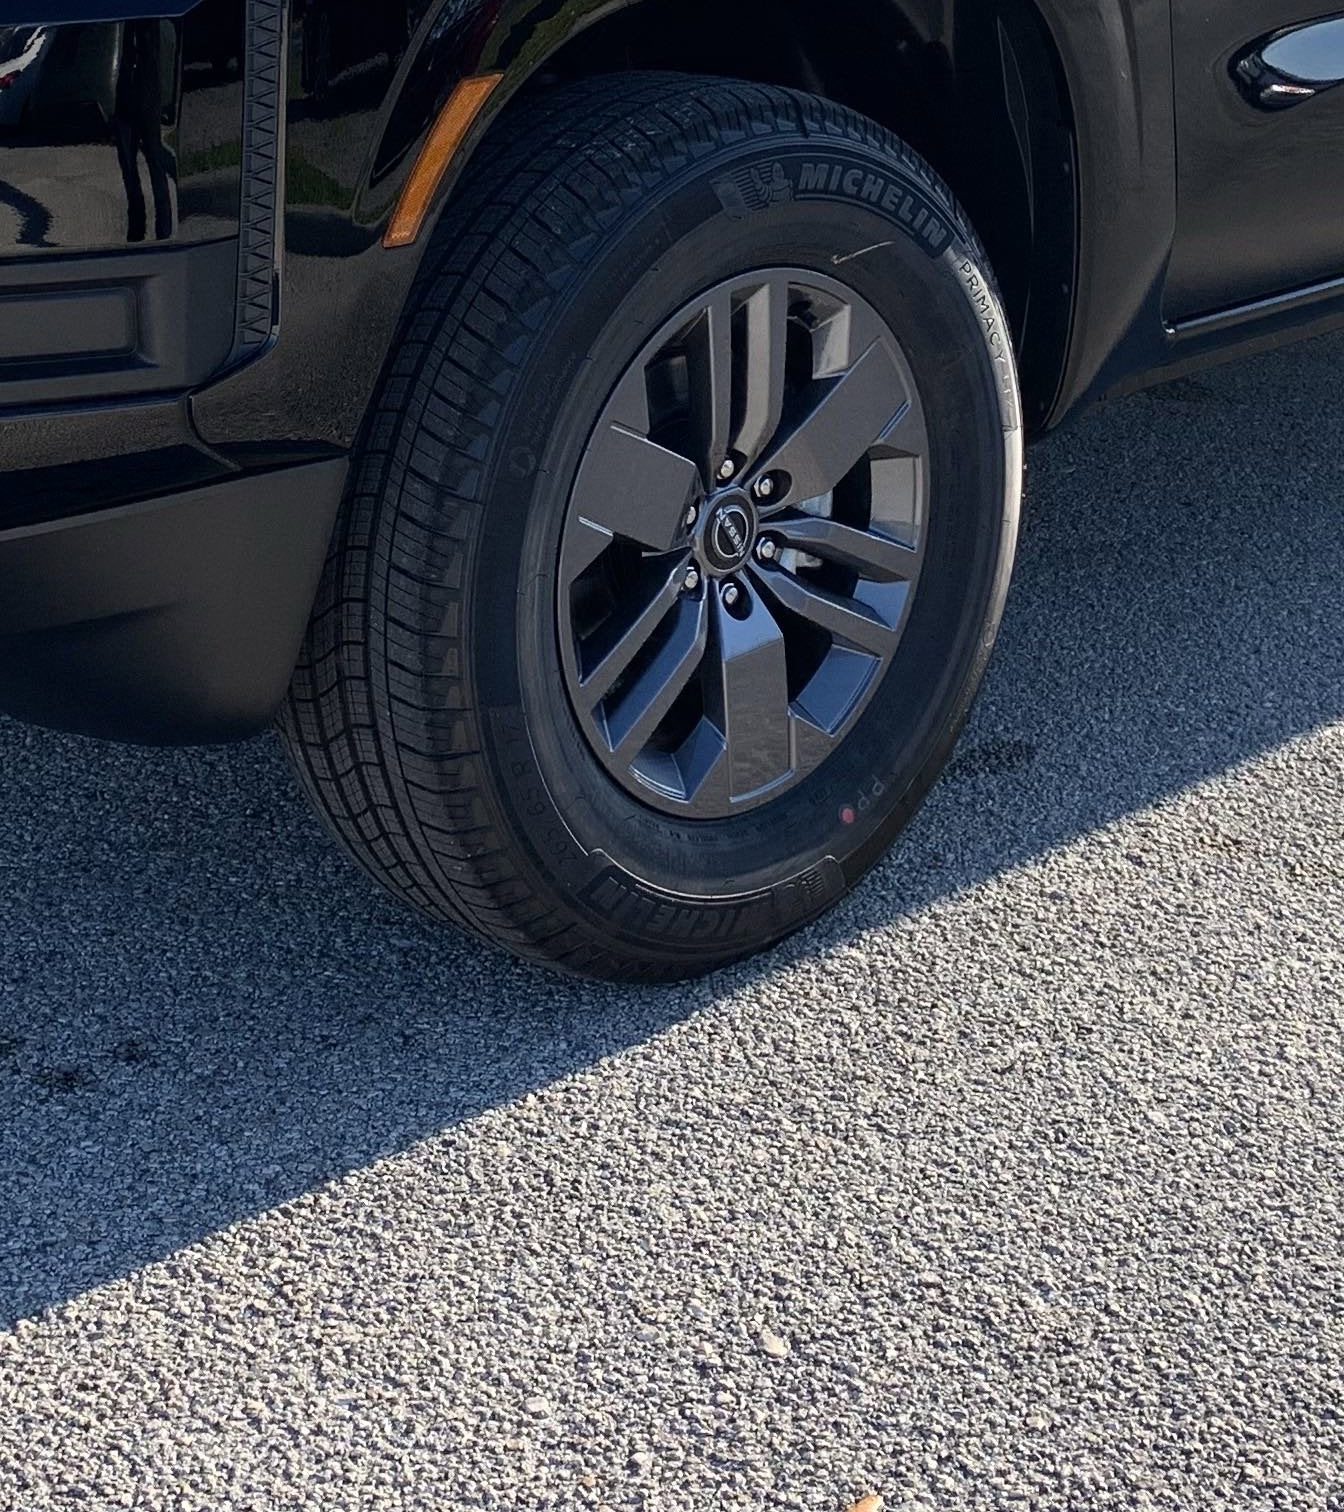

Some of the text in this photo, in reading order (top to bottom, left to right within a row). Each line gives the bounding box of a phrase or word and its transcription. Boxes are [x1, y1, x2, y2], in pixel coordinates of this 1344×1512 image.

[798, 162, 948, 248] MICHELIN
[959, 261, 1007, 362] PRIMACY
[716, 506, 745, 558] NISSAN
